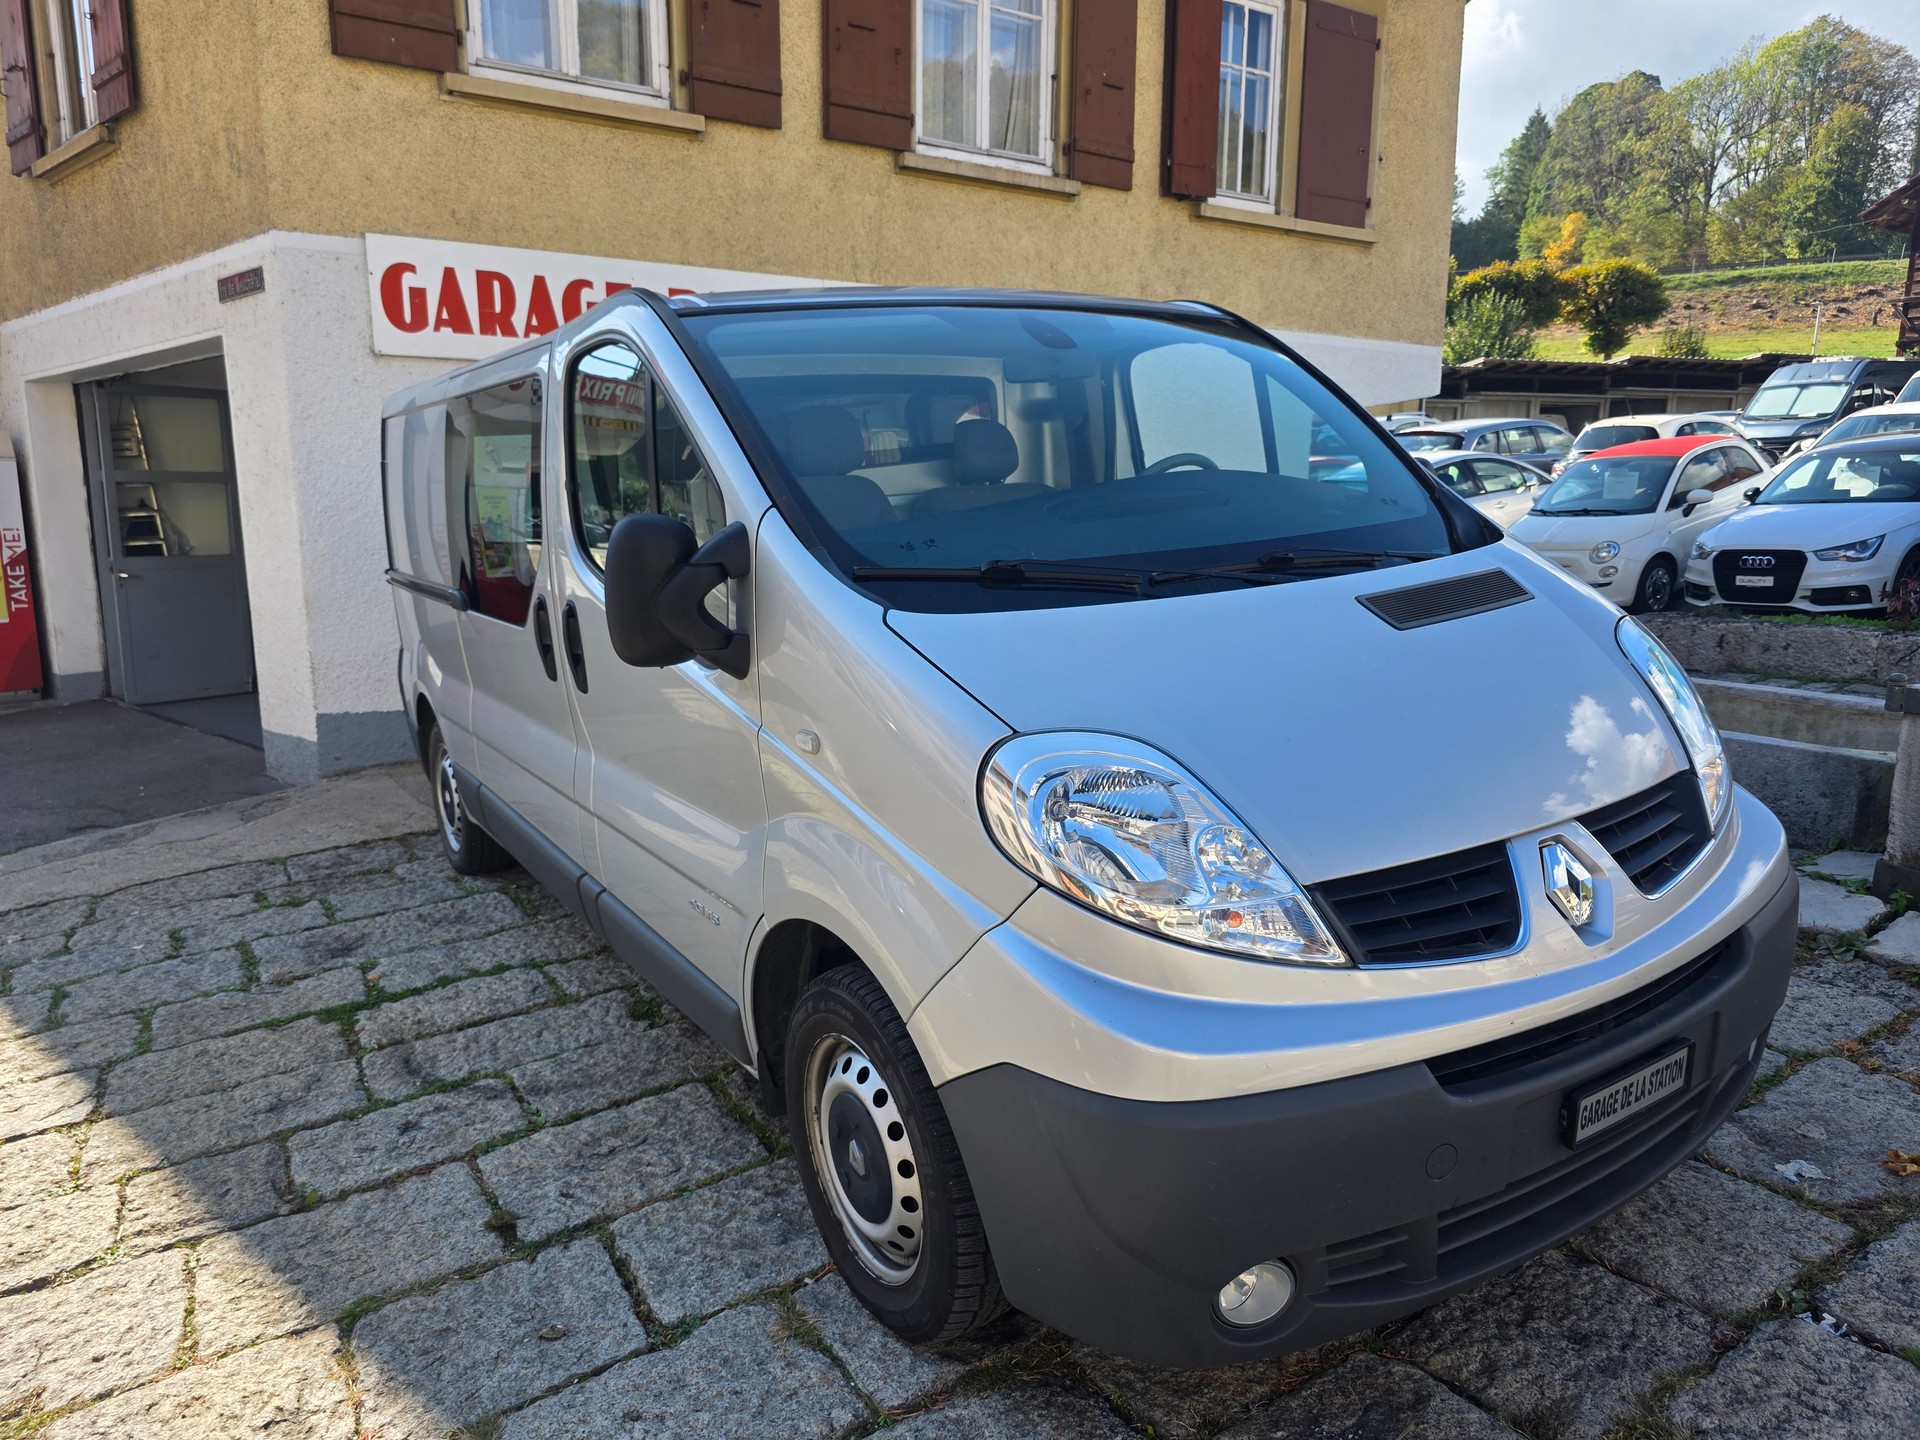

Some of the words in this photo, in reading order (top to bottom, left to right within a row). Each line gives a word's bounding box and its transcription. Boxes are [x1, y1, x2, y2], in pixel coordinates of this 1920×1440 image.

[379, 262, 632, 339] GARAG
[3, 527, 22, 560] ME!
[7, 565, 29, 612] TAKE
[1580, 1089, 1620, 1131] GARAGE
[1620, 1081, 1634, 1111] DE
[1634, 1075, 1646, 1103] LA
[1647, 1055, 1685, 1096] STATION
